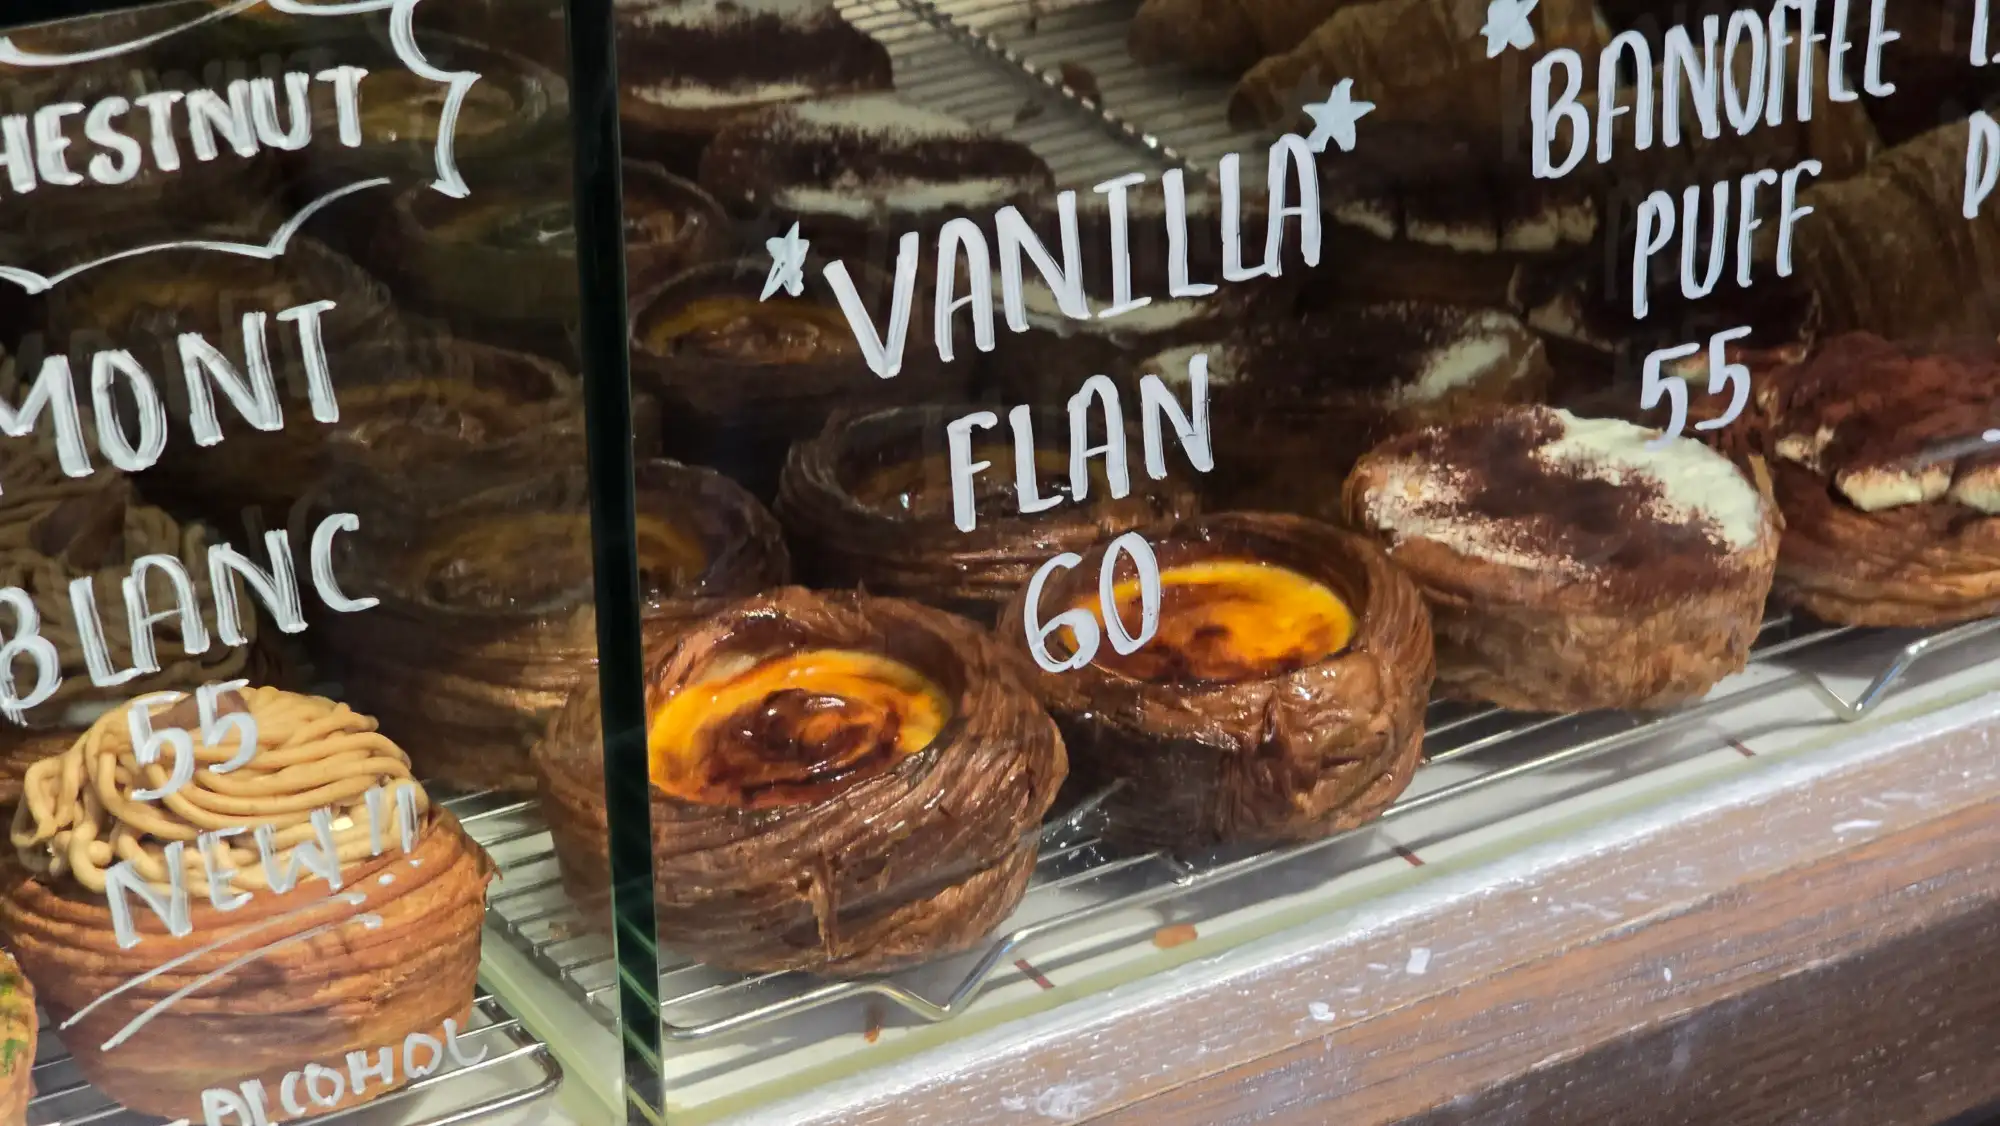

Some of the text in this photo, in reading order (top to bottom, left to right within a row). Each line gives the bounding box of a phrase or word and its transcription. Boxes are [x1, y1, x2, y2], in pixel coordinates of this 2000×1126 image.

[1531, 0, 1900, 179] BANOFFEE
[822, 133, 1321, 378] VANILLA
[1632, 160, 1822, 319] PUFF
[0, 300, 338, 480] MONT
[947, 353, 1215, 533] FLAN
[1640, 326, 1752, 452] 55
[0, 512, 380, 727] BLANC
[1024, 532, 1160, 673] 60
[128, 679, 258, 800] 55
